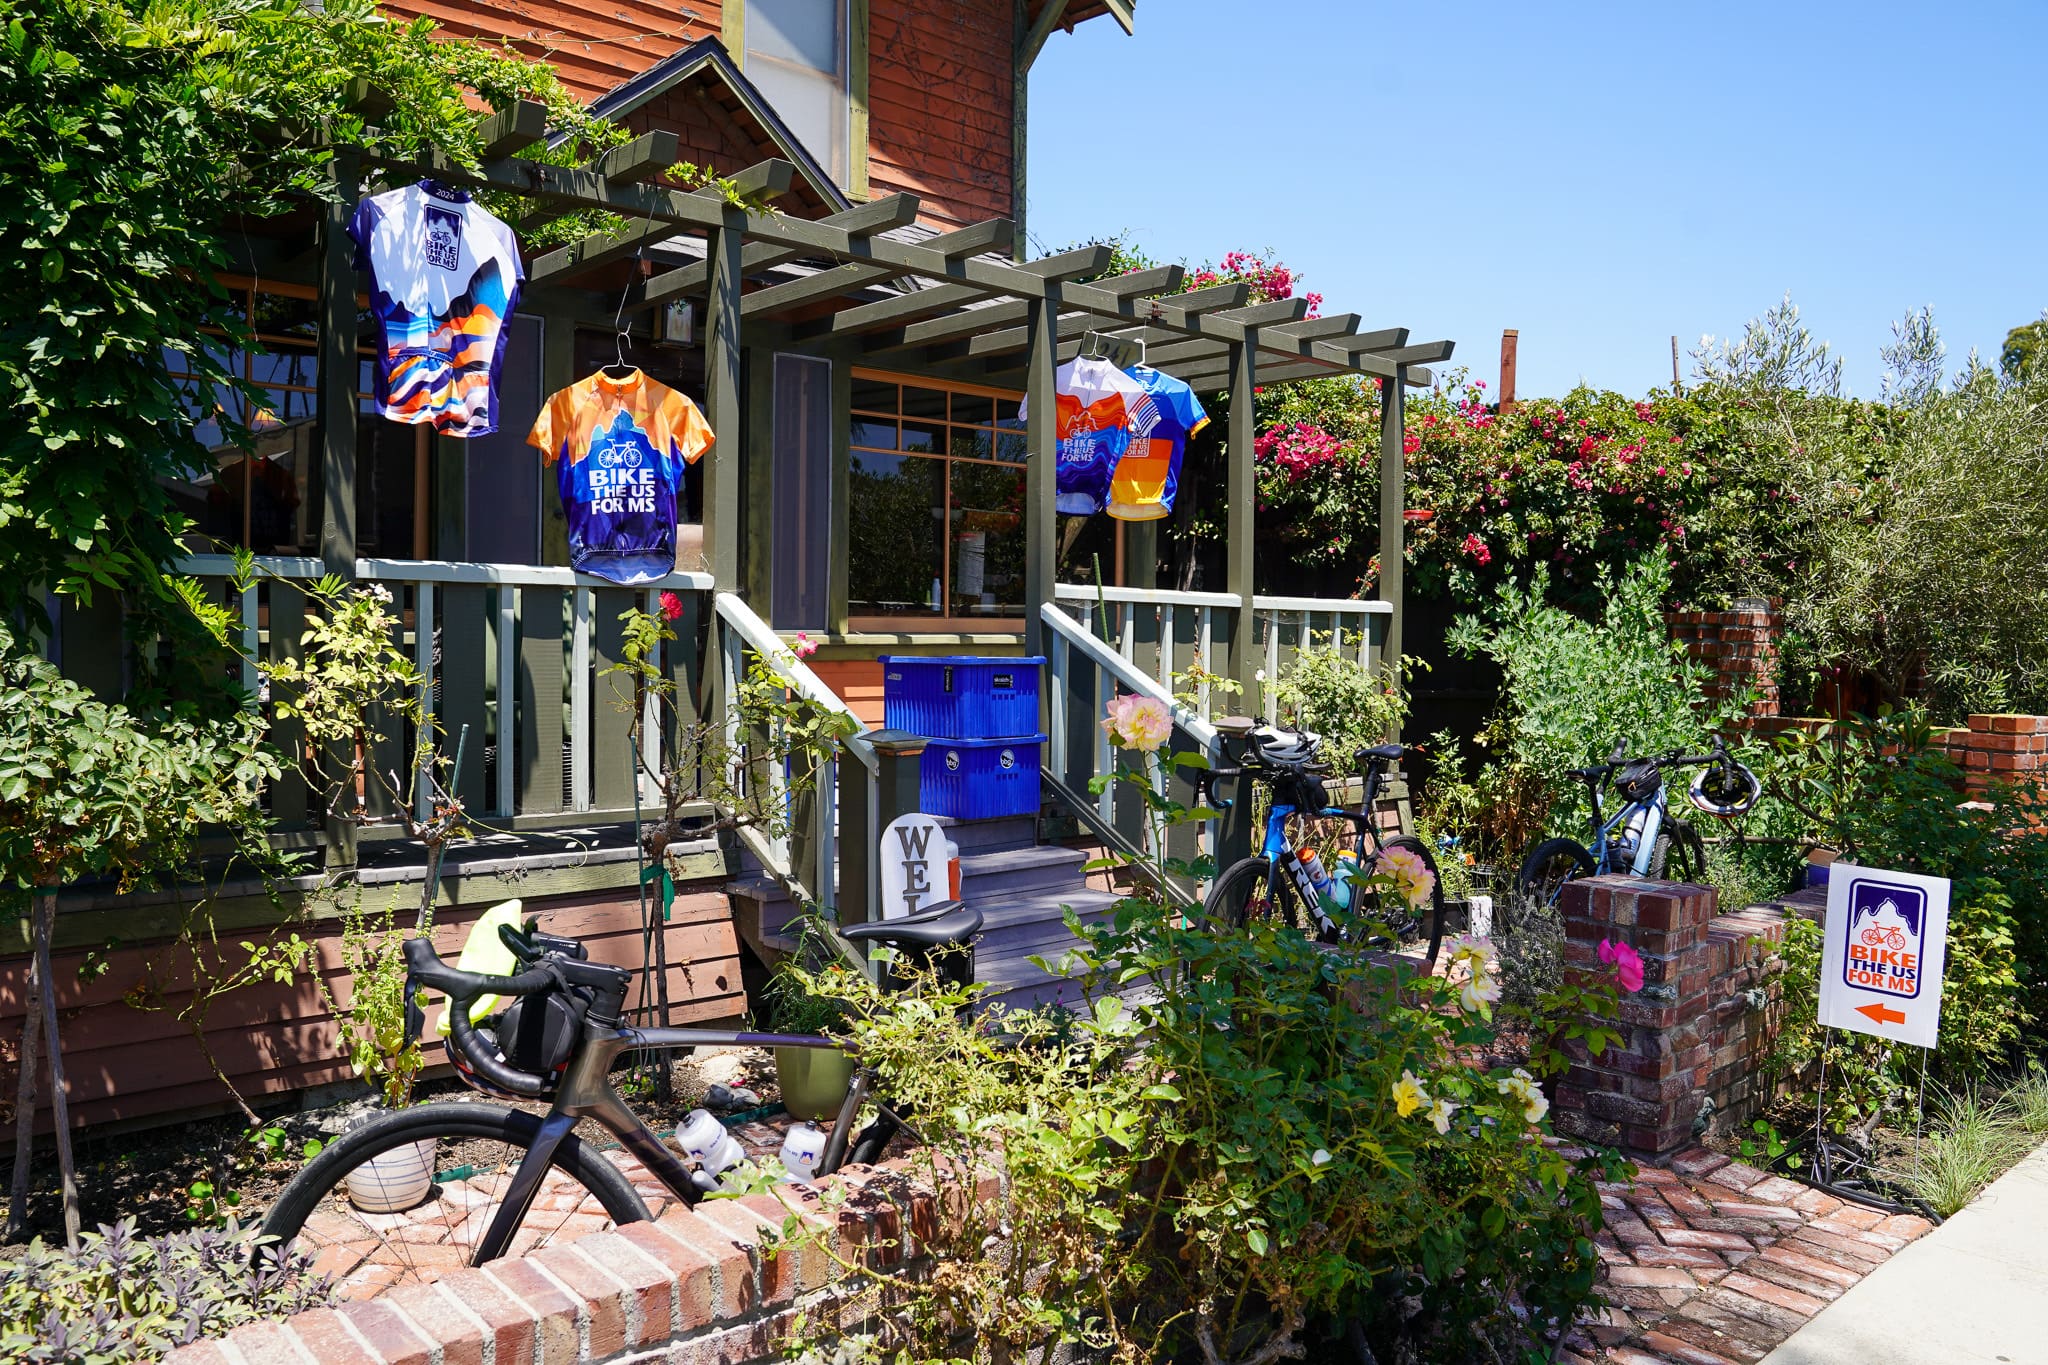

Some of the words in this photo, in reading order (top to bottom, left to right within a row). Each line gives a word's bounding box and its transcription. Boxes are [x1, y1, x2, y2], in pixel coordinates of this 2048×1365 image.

[435, 188, 455, 200] 2024
[426, 240, 457, 255] BIKE
[443, 258, 456, 268] MS
[444, 253, 456, 261] US
[1063, 438, 1097, 448] BIKE
[1061, 453, 1080, 463] FOR
[1082, 447, 1095, 455] US
[589, 468, 656, 487] BIKE
[590, 485, 626, 499] THE
[631, 485, 656, 497] US
[591, 498, 625, 515] FOR
[628, 498, 656, 512] MS
[1850, 944, 1917, 969] BIKE
[1850, 958, 1887, 975] THE
[1892, 966, 1916, 980] US
[1848, 968, 1884, 987] FOR
[1888, 976, 1915, 993] MS
